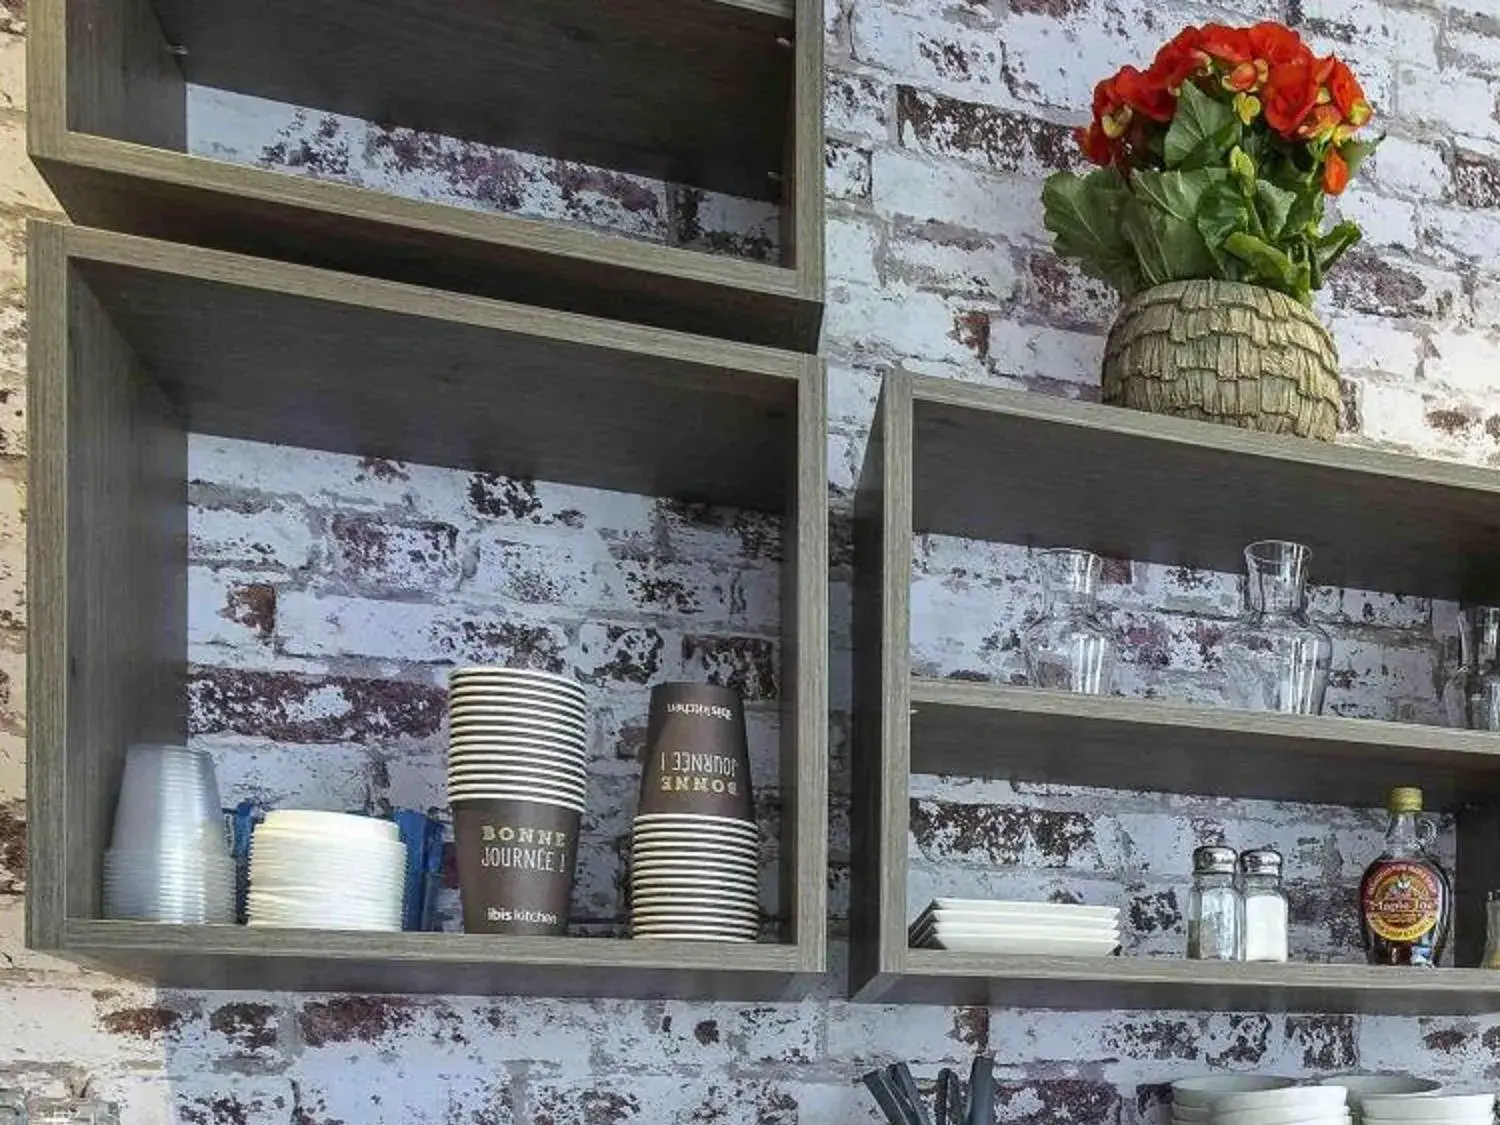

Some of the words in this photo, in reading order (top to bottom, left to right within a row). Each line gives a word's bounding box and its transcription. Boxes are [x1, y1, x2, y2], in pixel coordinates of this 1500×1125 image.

[661, 775, 737, 796] BONNE
[482, 826, 566, 847] BONNE
[487, 907, 513, 922] ibis
[513, 909, 557, 925] kitchen
